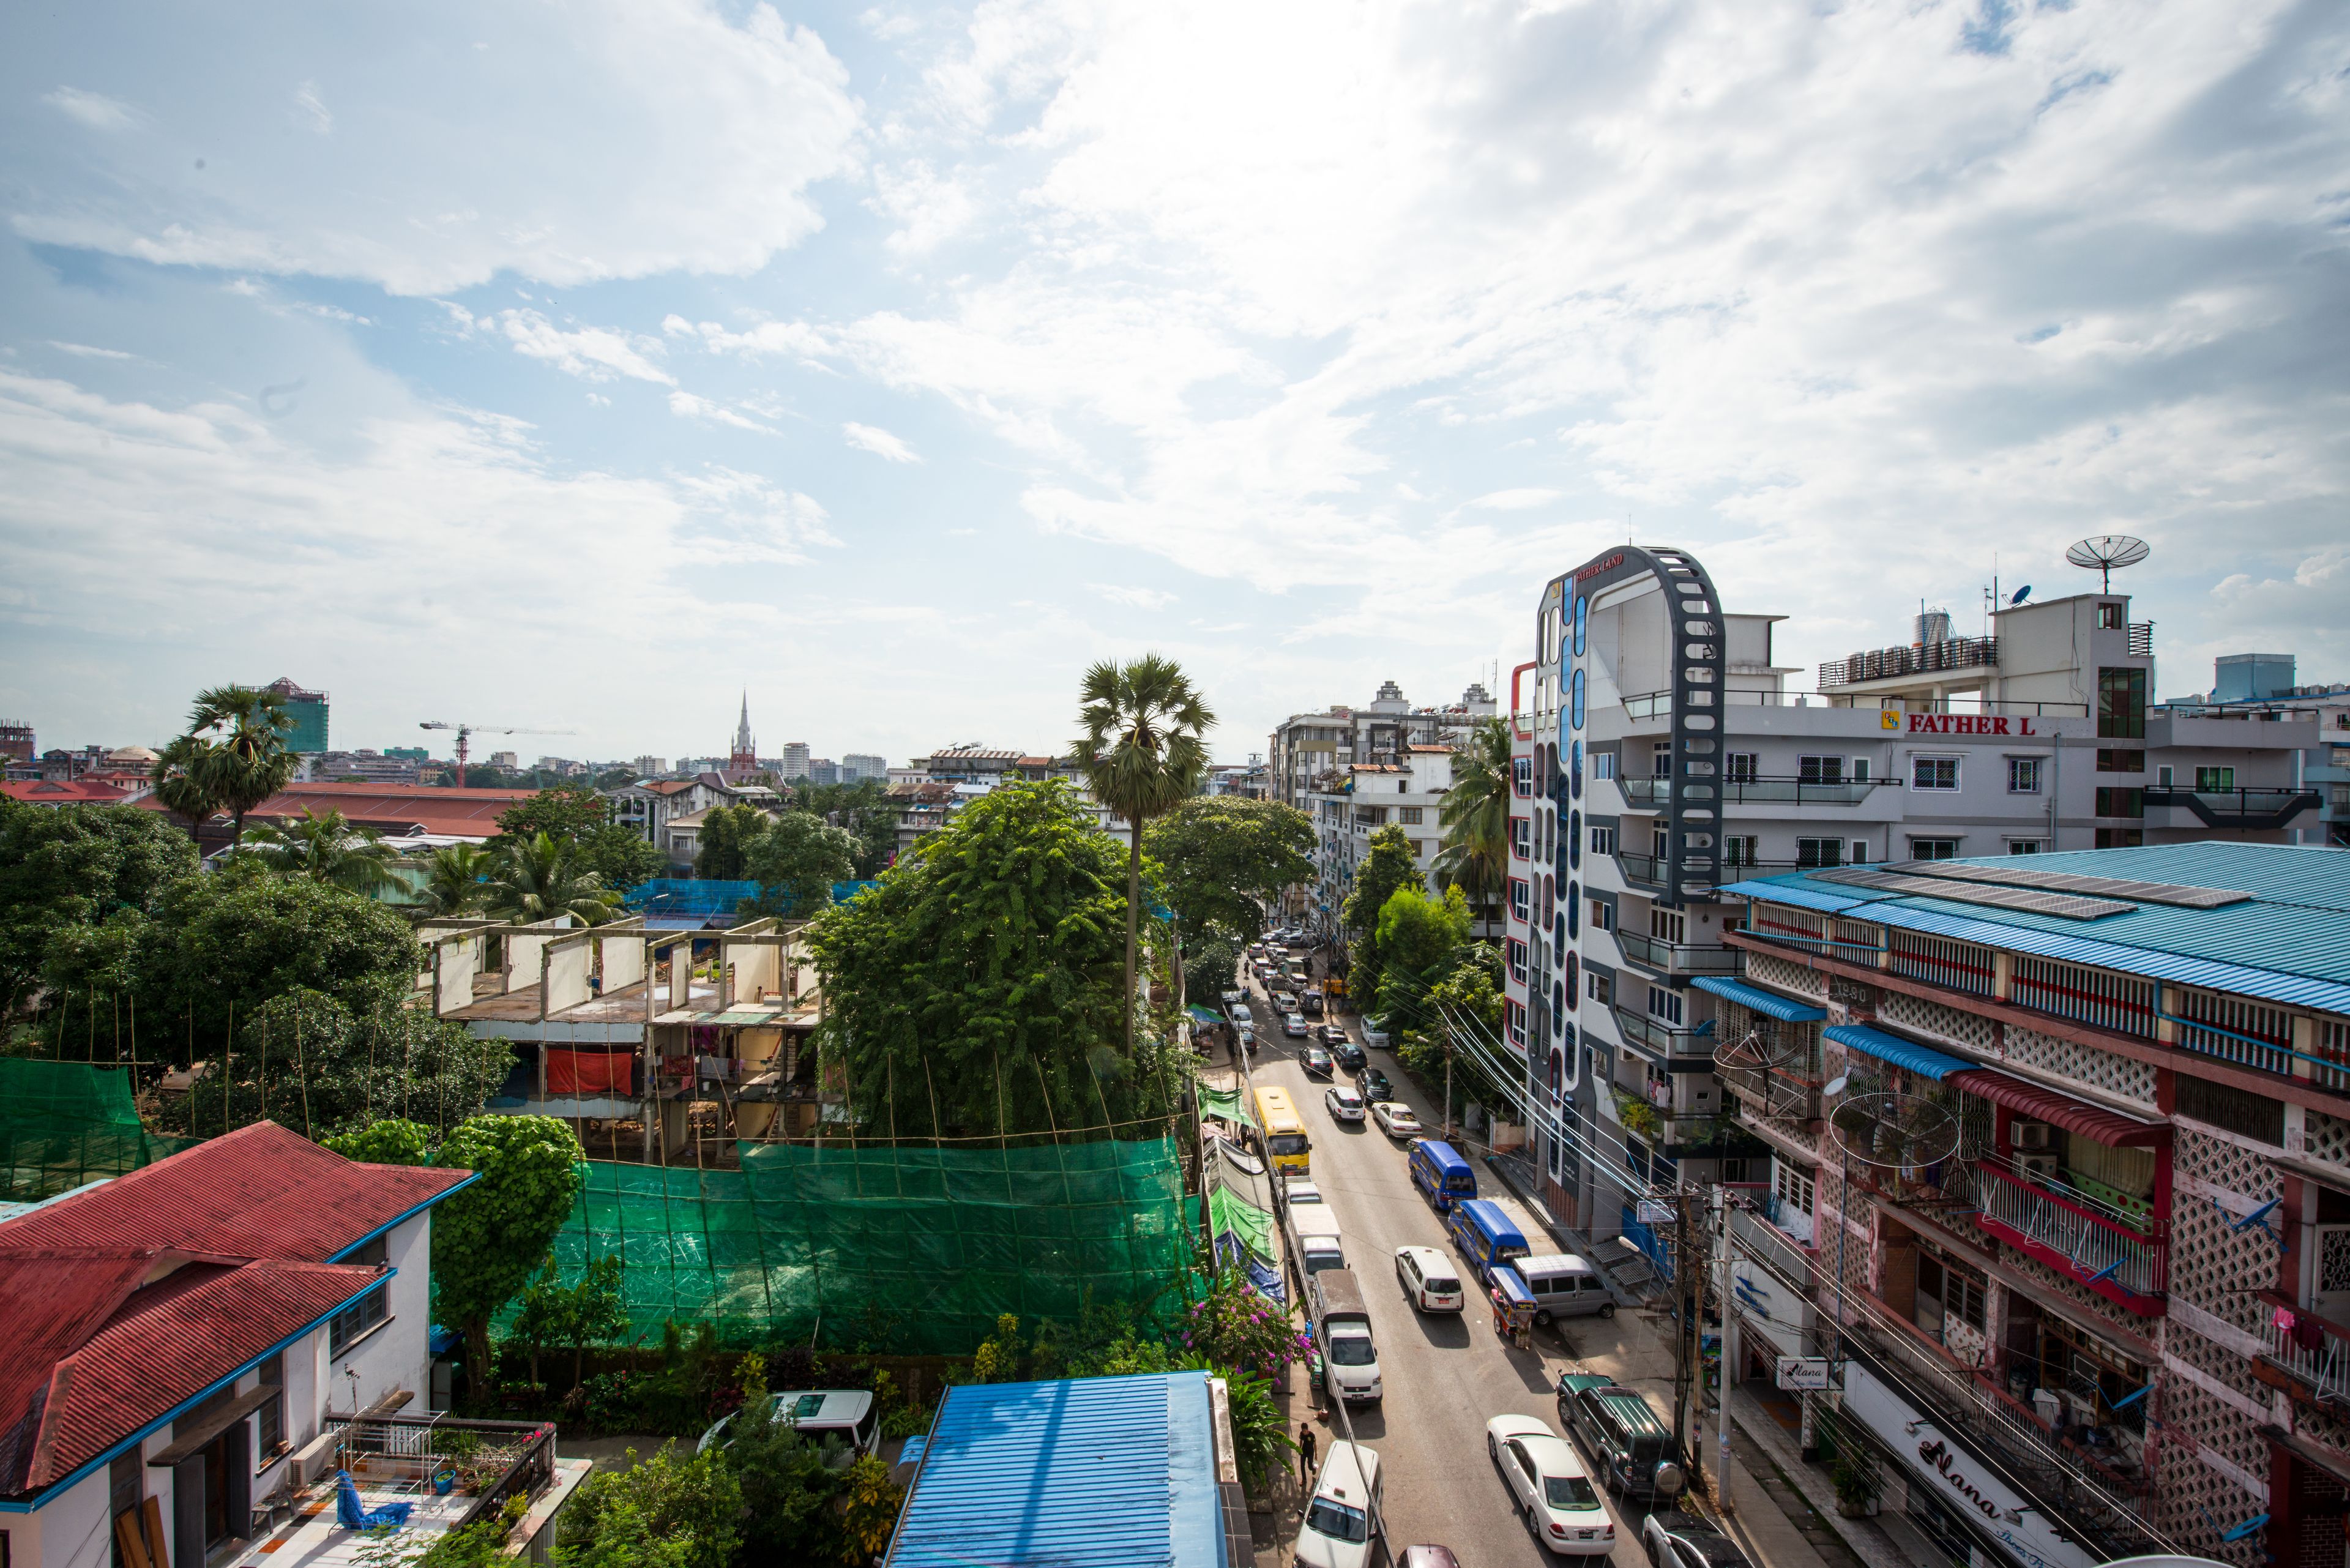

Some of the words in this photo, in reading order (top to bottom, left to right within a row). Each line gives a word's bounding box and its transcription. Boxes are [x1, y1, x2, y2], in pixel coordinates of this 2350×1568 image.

[1576, 564, 1600, 583] FATHER
[1602, 553, 1624, 571] LAND
[1908, 714, 2010, 734] FATHER
[2020, 718, 2035, 735] L
[1786, 1363, 1823, 1376] Alana
[1919, 1441, 2001, 1519] Alana
